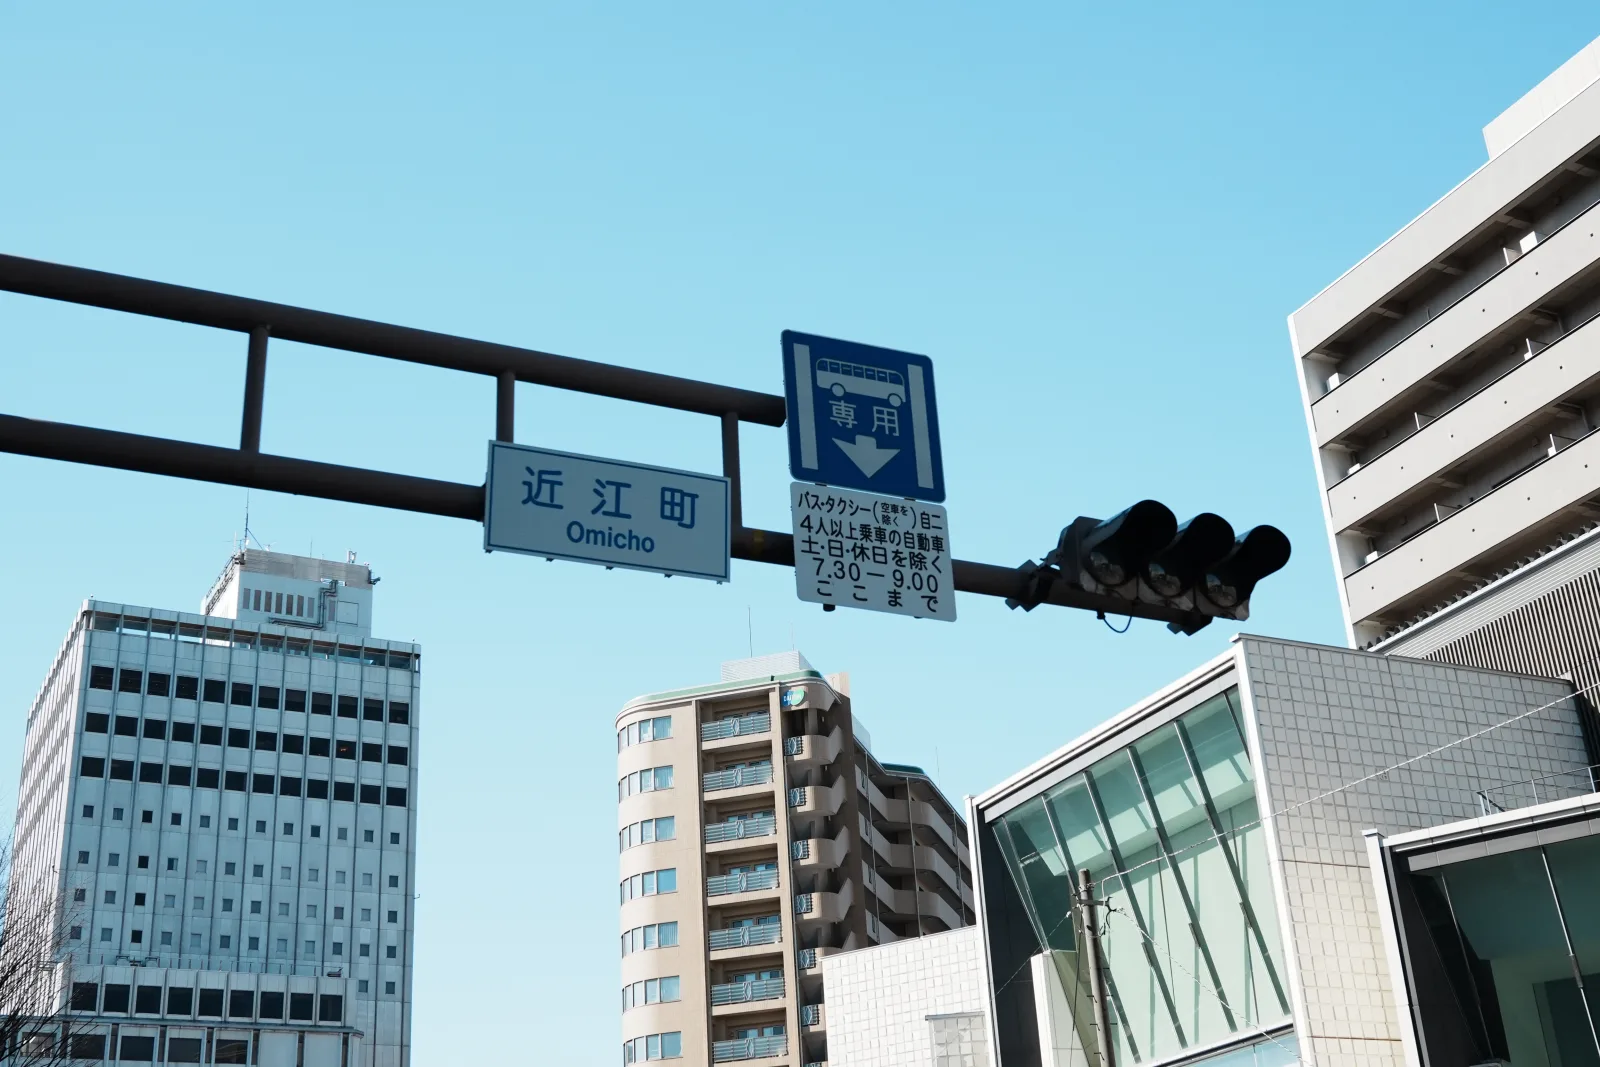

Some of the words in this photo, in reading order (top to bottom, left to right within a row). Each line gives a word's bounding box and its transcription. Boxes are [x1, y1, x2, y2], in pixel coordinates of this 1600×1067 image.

[829, 400, 900, 437] 専用
[521, 466, 699, 529] 近江町
[566, 520, 655, 553] Omicho
[800, 514, 945, 553] 4人以上乗車の自動車
[817, 579, 939, 613] ここまで
